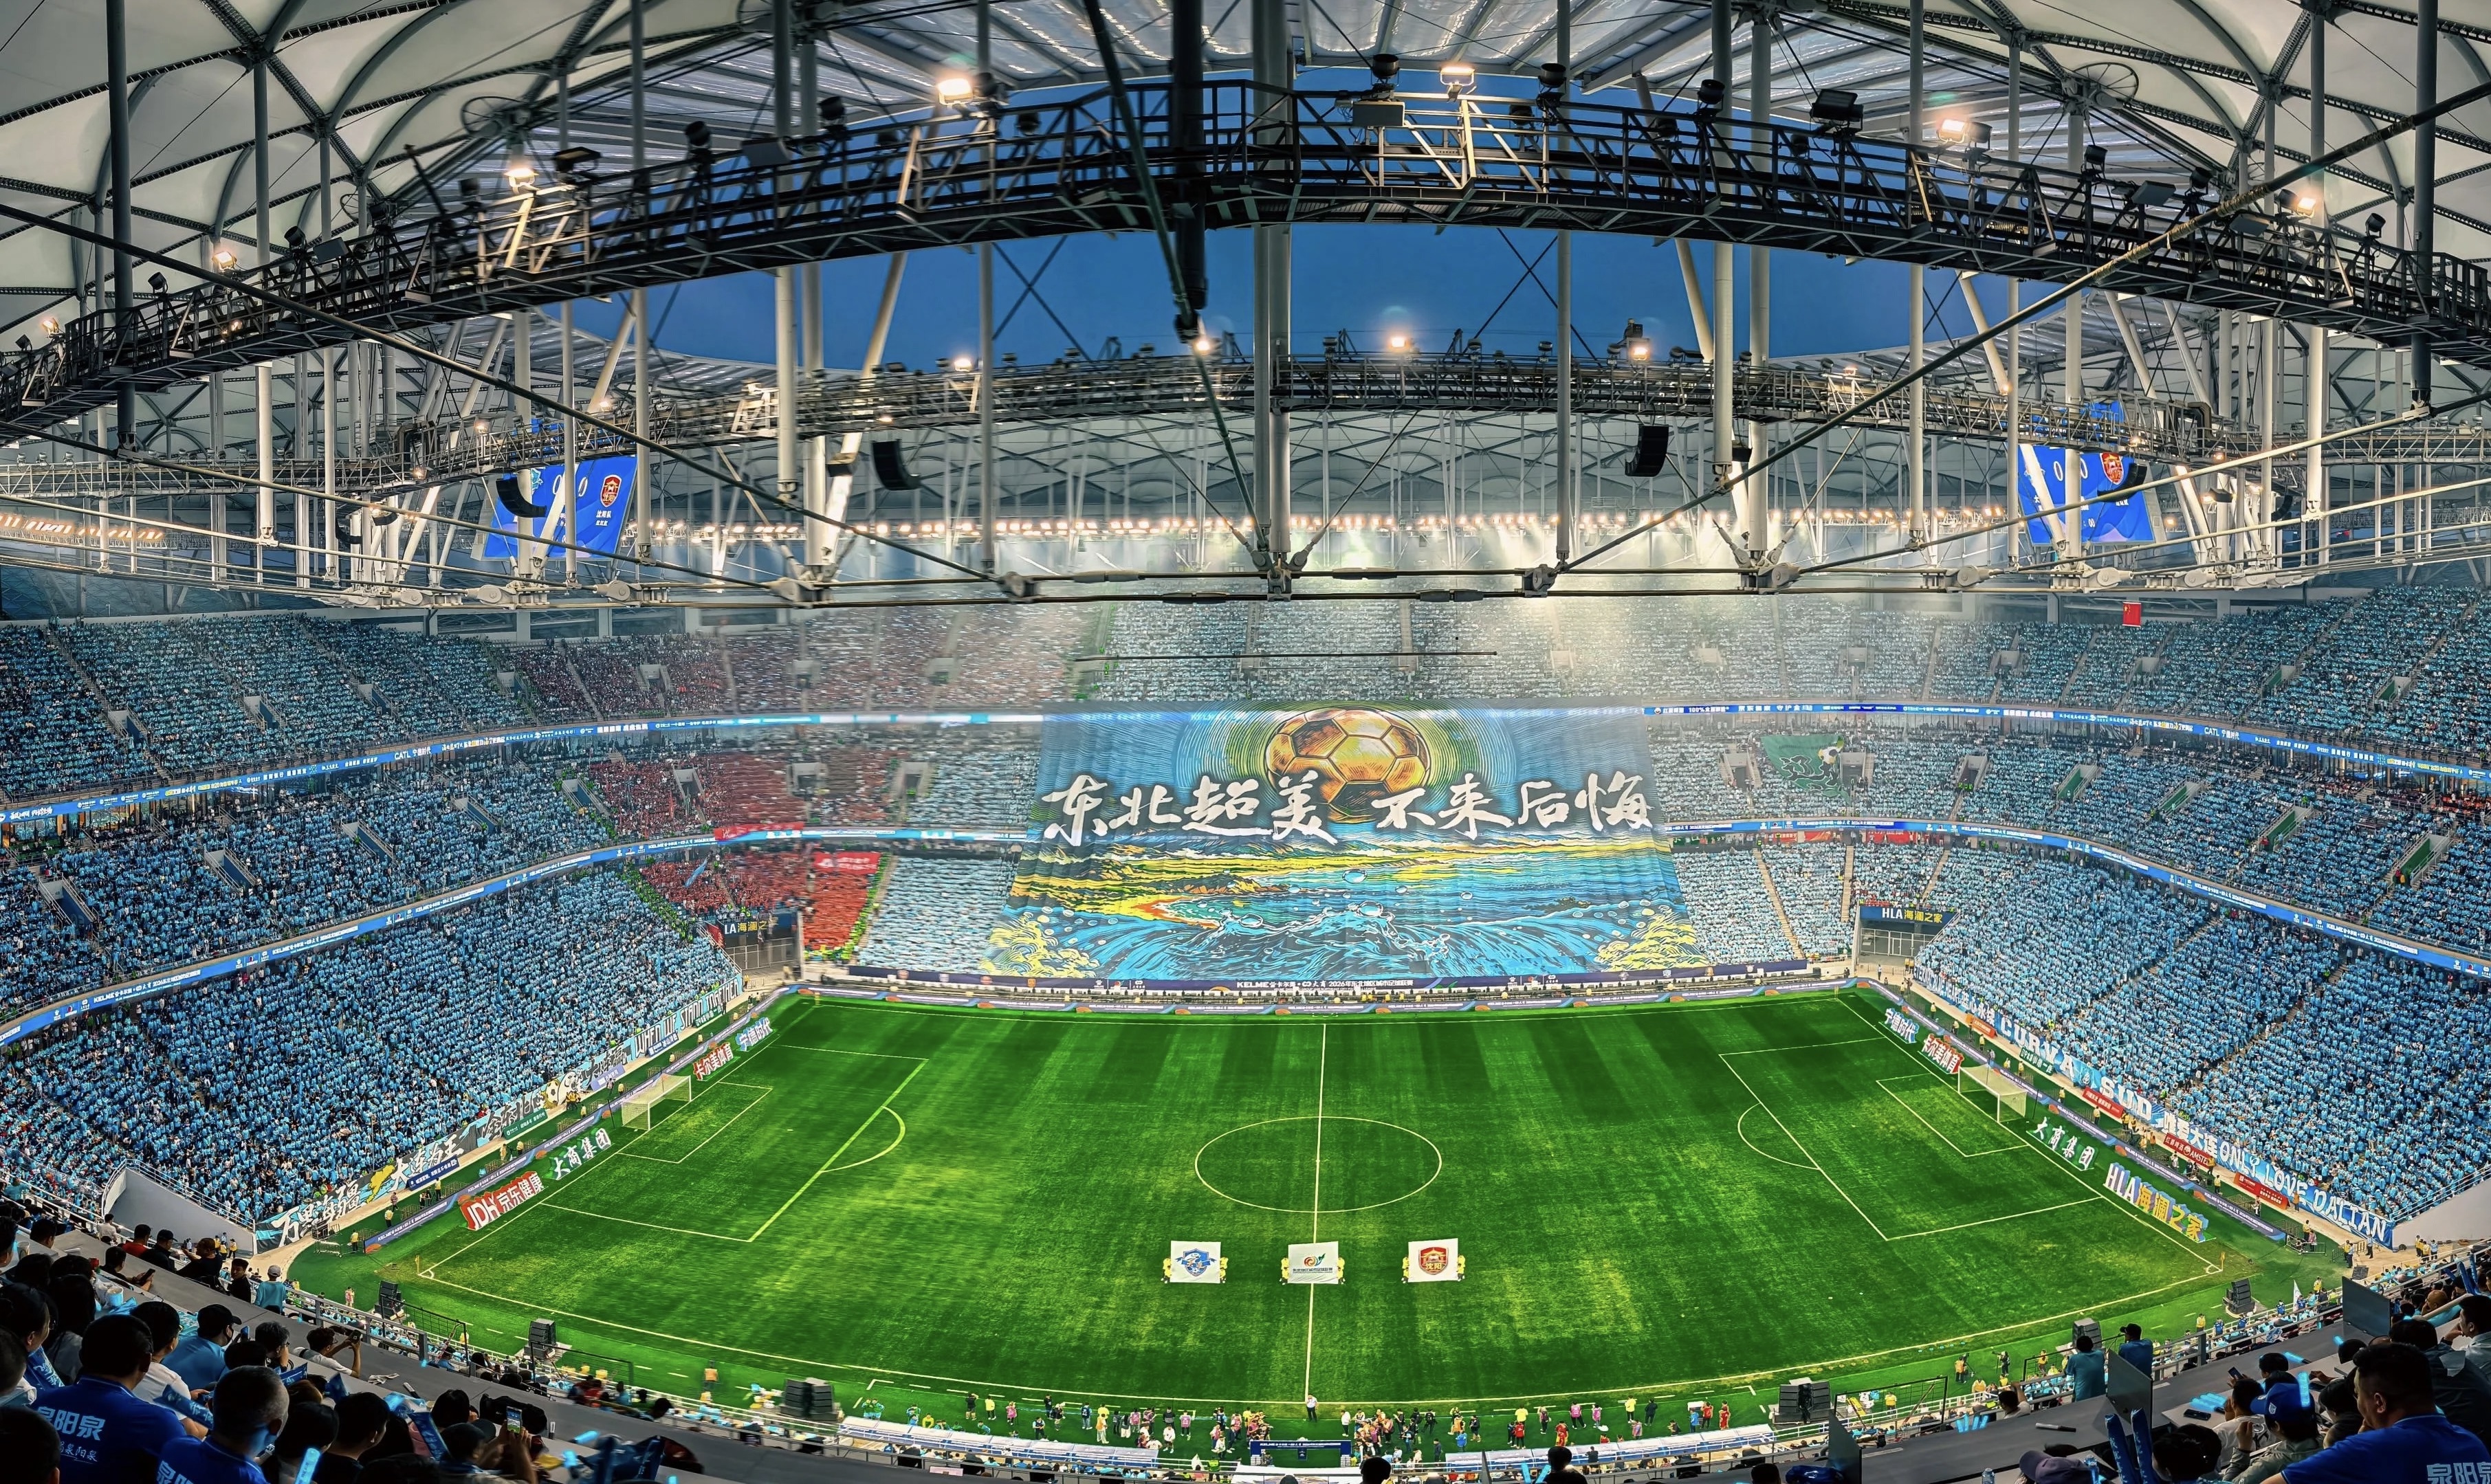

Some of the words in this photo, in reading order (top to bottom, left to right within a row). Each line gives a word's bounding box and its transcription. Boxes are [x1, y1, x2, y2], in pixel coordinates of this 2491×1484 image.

[578, 477, 588, 496] 0
[2053, 461, 2063, 481] 0
[2204, 727, 2220, 736] CATL
[394, 751, 411, 760] CATL
[1042, 771, 1337, 847] 东北超美
[1373, 770, 1654, 839] 不来后悔
[1882, 907, 1902, 919] HLA
[1904, 909, 1943, 923] 海澜之家
[635, 1024, 661, 1059] WHEN
[663, 1015, 677, 1038] WE
[680, 998, 704, 1031] STAND
[739, 1017, 773, 1050] 宁德时代
[1884, 1008, 1916, 1043] 宁德时代
[695, 1043, 734, 1079] 卡尔美体育
[1922, 1034, 1960, 1074] 卡尔美体育
[2000, 1017, 2075, 1081] CURVA
[2099, 1076, 2152, 1121] SUD
[2162, 1111, 2218, 1157] 唯爱大连
[2219, 1141, 2260, 1177] ONLY
[2263, 1164, 2308, 1203] LOVE
[2312, 1189, 2387, 1241] DALIAN
[2034, 1117, 2095, 1171] 大商集团
[553, 1128, 612, 1181] 大商集团
[271, 1180, 361, 1248] 万里海疆
[389, 1134, 464, 1192] 大连为王
[467, 1196, 501, 1230] JDH
[496, 1172, 545, 1213] 京东健康
[2105, 1163, 2135, 1204] HLA
[2136, 1185, 2204, 1241] 海澜之家
[1425, 1262, 1442, 1270] 沈阳
